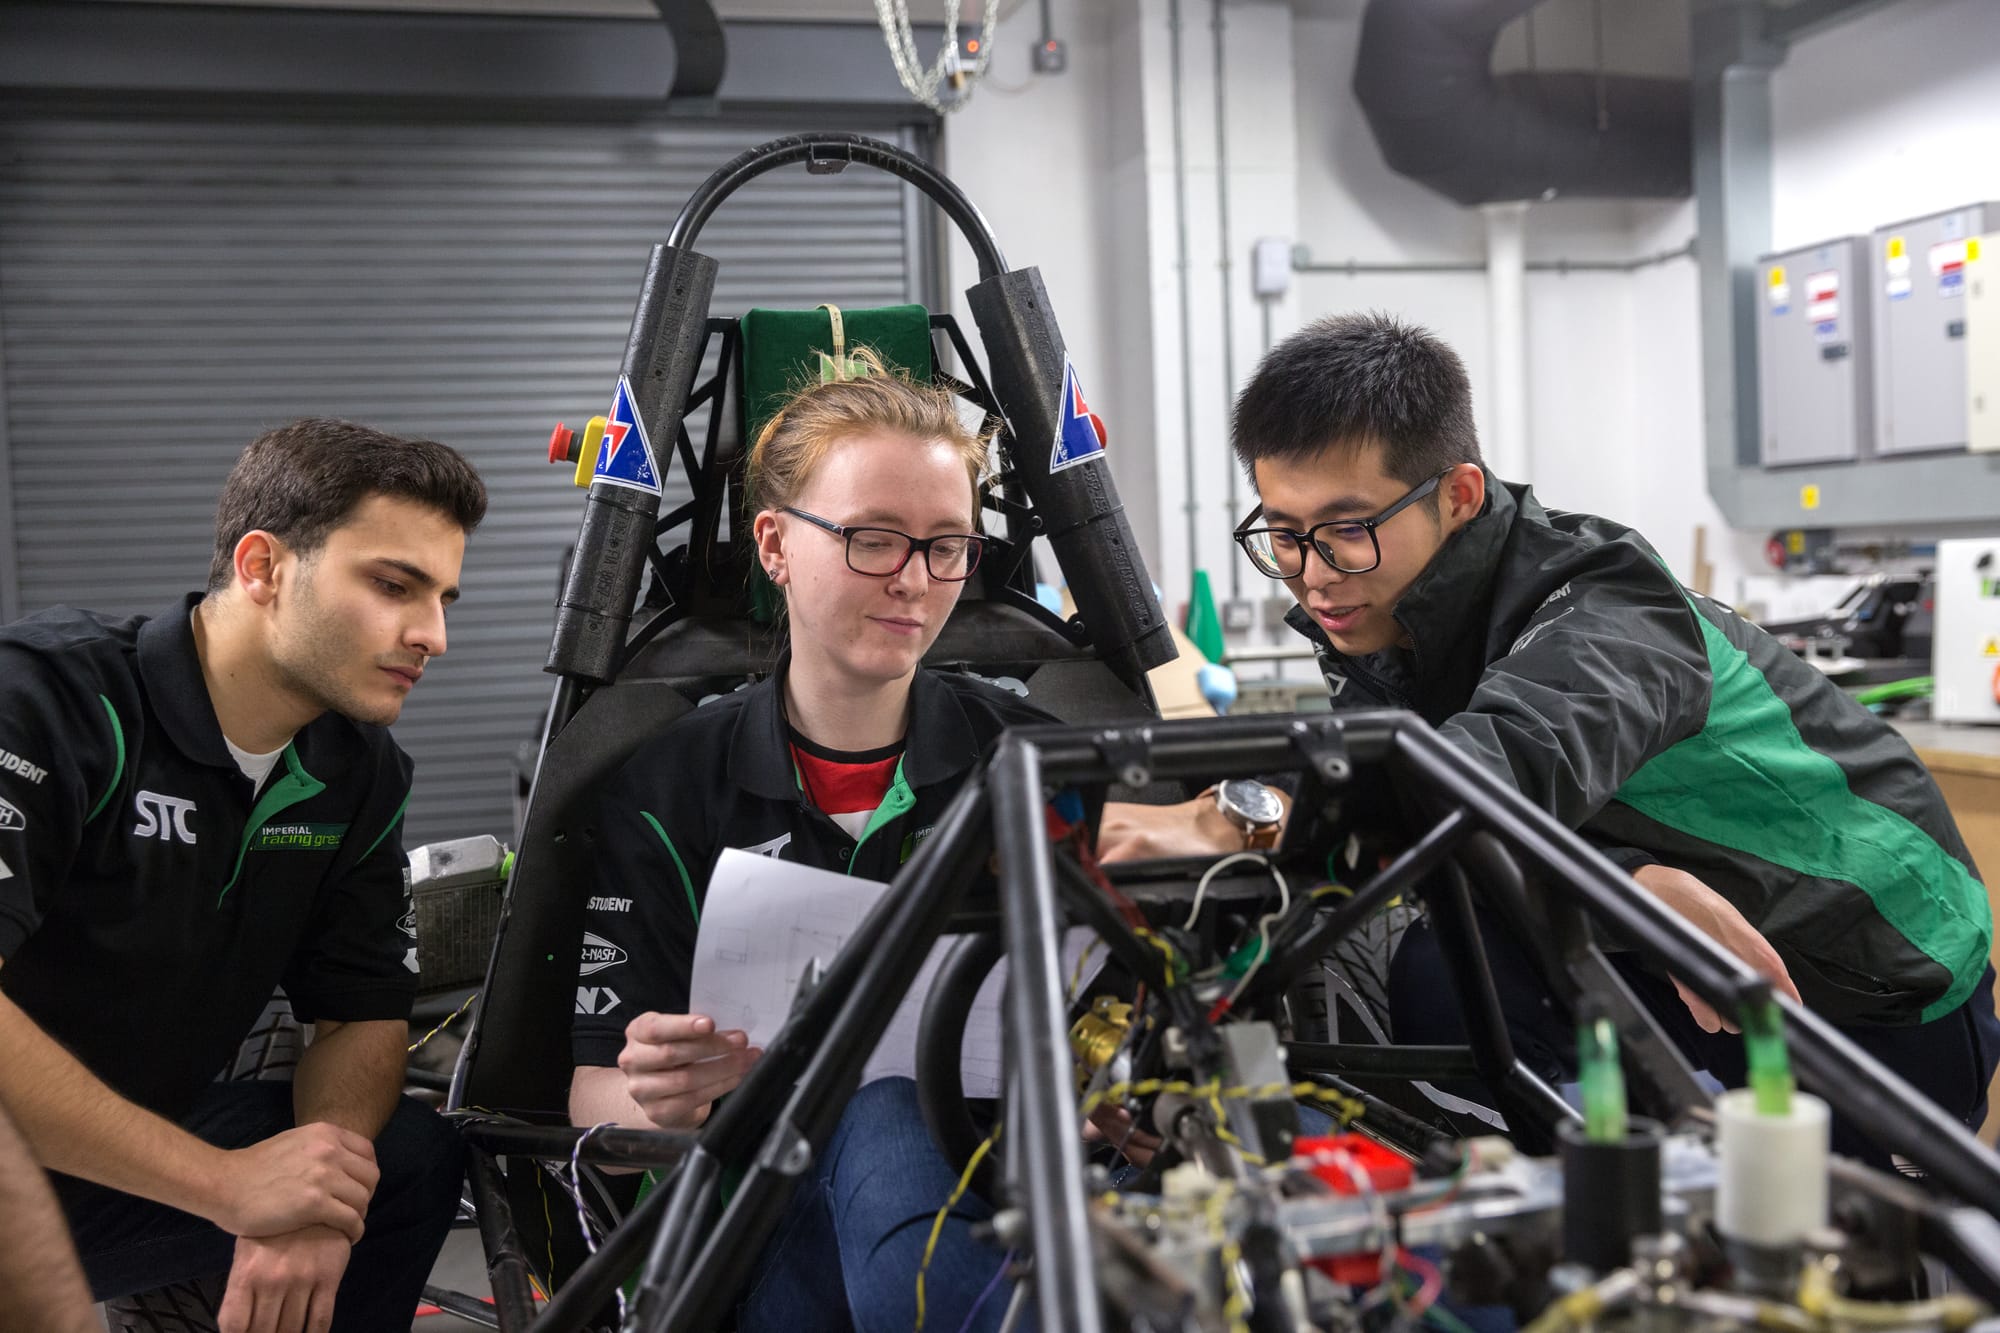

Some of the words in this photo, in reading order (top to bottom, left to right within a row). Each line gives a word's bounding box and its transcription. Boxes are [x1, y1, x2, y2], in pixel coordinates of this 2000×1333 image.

[134, 790, 197, 844] STC
[262, 825, 312, 836] IMPERIAL
[262, 834, 312, 847] racing
